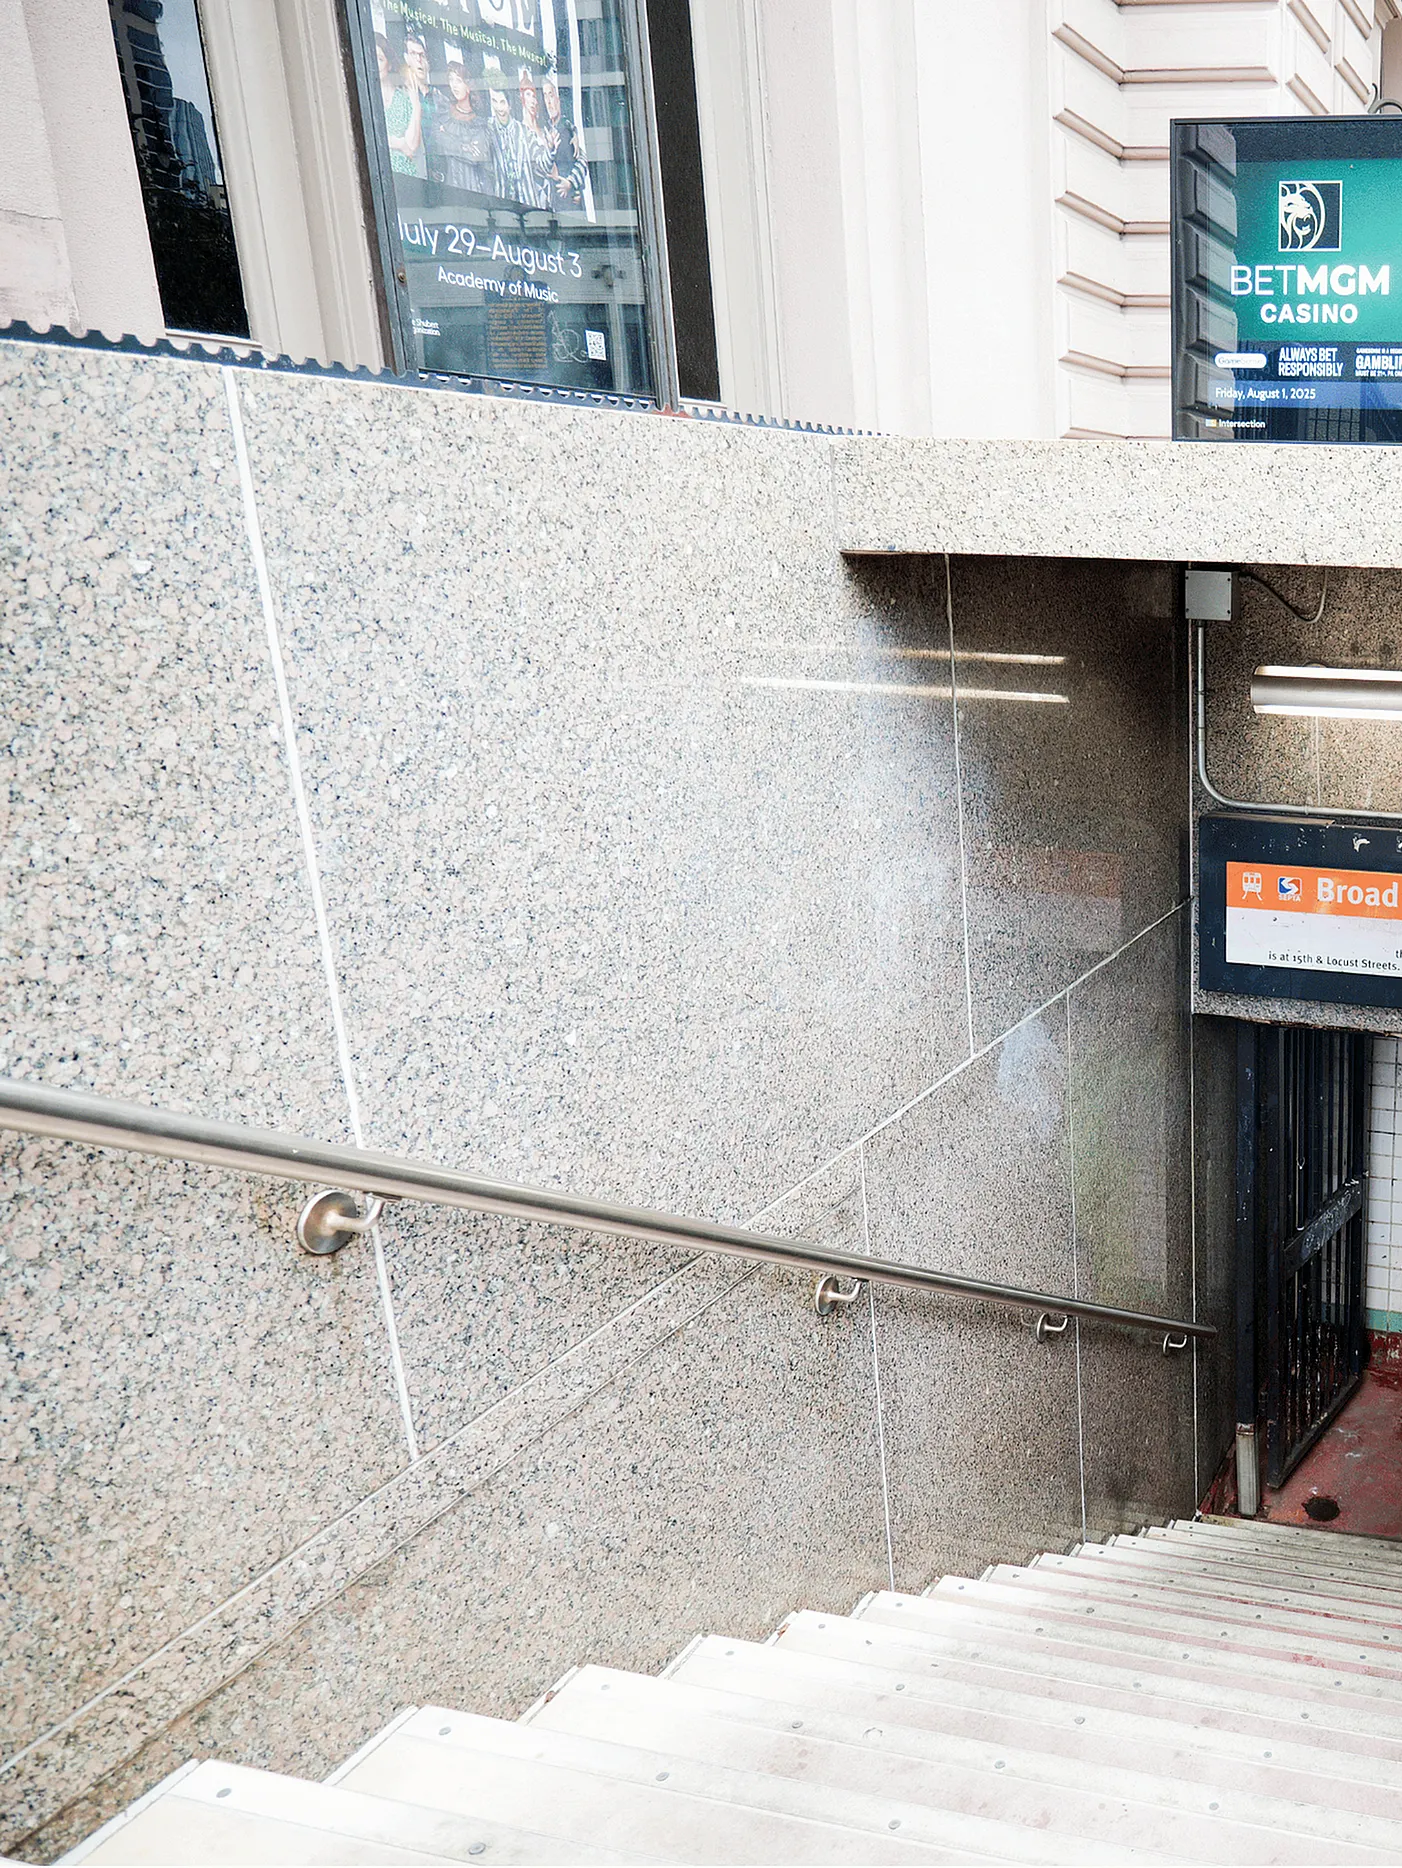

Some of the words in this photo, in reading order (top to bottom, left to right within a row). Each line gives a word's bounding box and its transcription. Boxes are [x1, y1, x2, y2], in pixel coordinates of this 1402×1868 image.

[400, 1, 439, 29] Musical.
[440, 17, 459, 36] The
[460, 24, 499, 50] Musical.
[501, 38, 517, 54] The
[518, 44, 548, 68] Musical.
[568, 252, 583, 279] 3
[438, 265, 506, 296] Academy
[509, 280, 522, 296] of
[524, 281, 560, 303] Music
[1230, 264, 1390, 297] BETMGM
[1260, 302, 1358, 324] CASINO
[1279, 347, 1317, 362] ALWAYS
[1319, 348, 1338, 362] BET
[1278, 362, 1344, 377] RESPONSIBLY
[1215, 388, 1245, 401] Friday,
[1247, 388, 1279, 401] August
[1281, 388, 1288, 400] 1,
[1290, 388, 1316, 399] 2025
[1218, 419, 1266, 429] Intersection
[1316, 877, 1399, 909] Broad
[1268, 950, 1277, 961] is
[1279, 951, 1289, 962] at
[1292, 952, 1313, 965] 15th
[1316, 955, 1323, 964] &
[1326, 955, 1358, 968] Locust
[1361, 959, 1401, 971] Streets.
